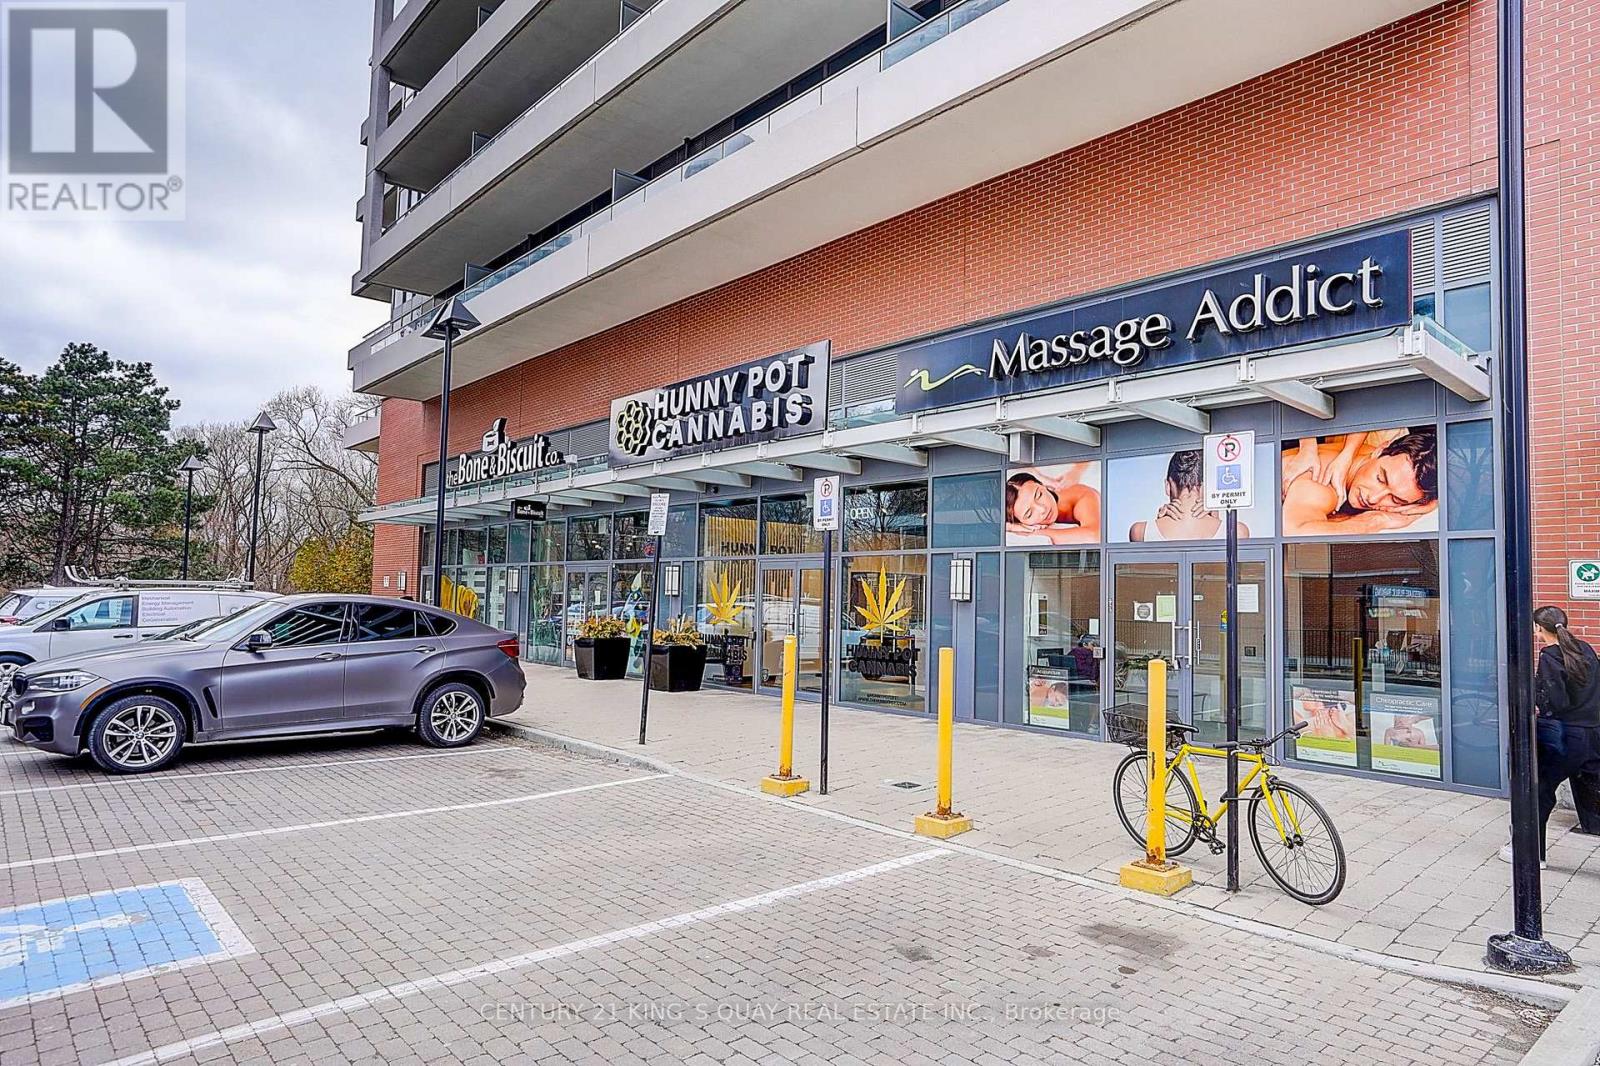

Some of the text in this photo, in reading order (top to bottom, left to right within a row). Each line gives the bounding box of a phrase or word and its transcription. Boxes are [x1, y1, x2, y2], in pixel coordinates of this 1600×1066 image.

[987, 257, 1384, 379] Massage Addict
[654, 353, 806, 420] HUNNY POT
[651, 393, 804, 449] CANNABIS
[458, 453, 488, 484] Bone
[489, 457, 497, 475] &
[497, 434, 545, 476] Biscuit
[545, 451, 560, 466] co.
[851, 508, 874, 520] OPEN
